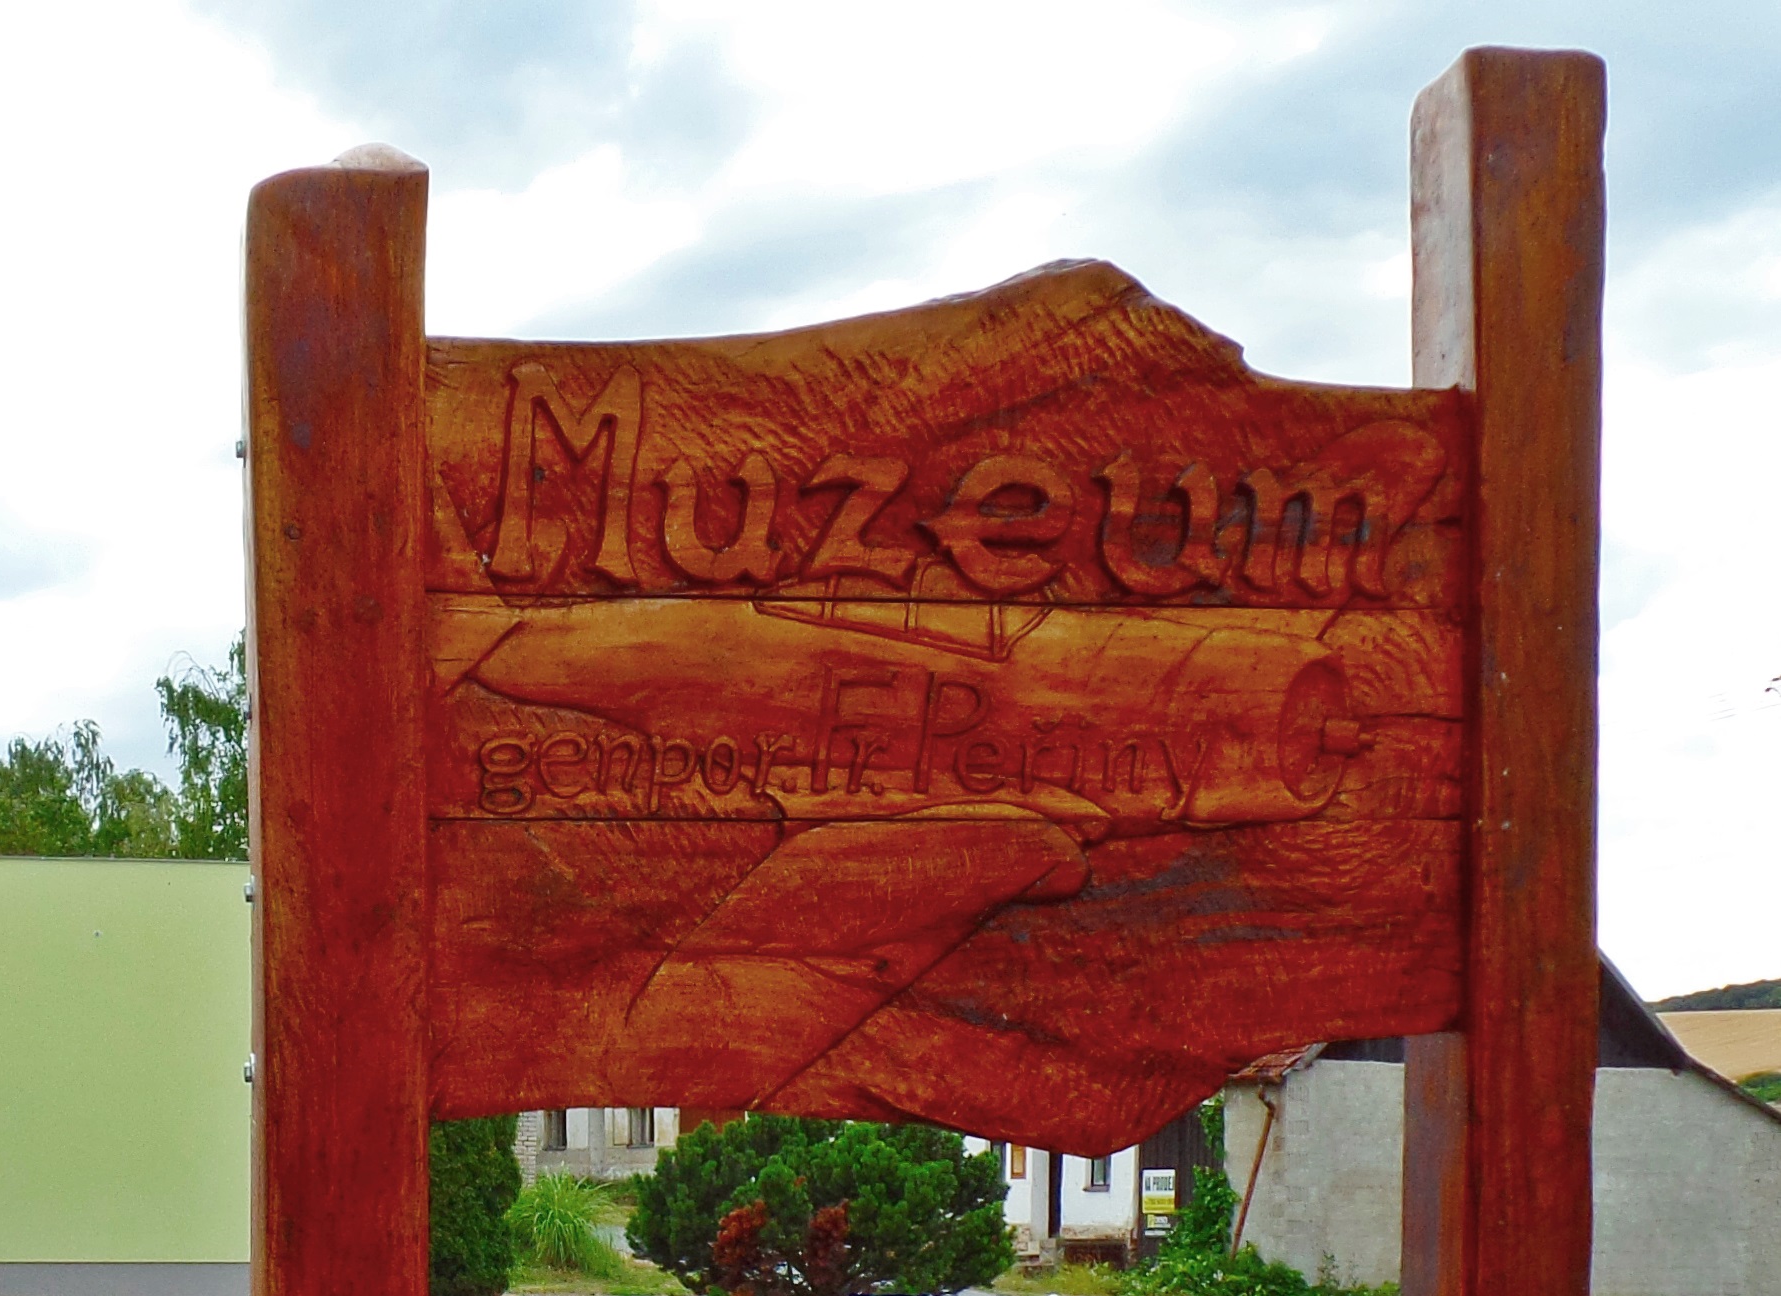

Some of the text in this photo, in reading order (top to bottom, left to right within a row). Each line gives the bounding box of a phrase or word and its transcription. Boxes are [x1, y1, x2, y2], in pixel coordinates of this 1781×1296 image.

[486, 360, 1390, 600] Muzeum
[478, 730, 797, 815] genpor.
[810, 668, 883, 795] Fr.
